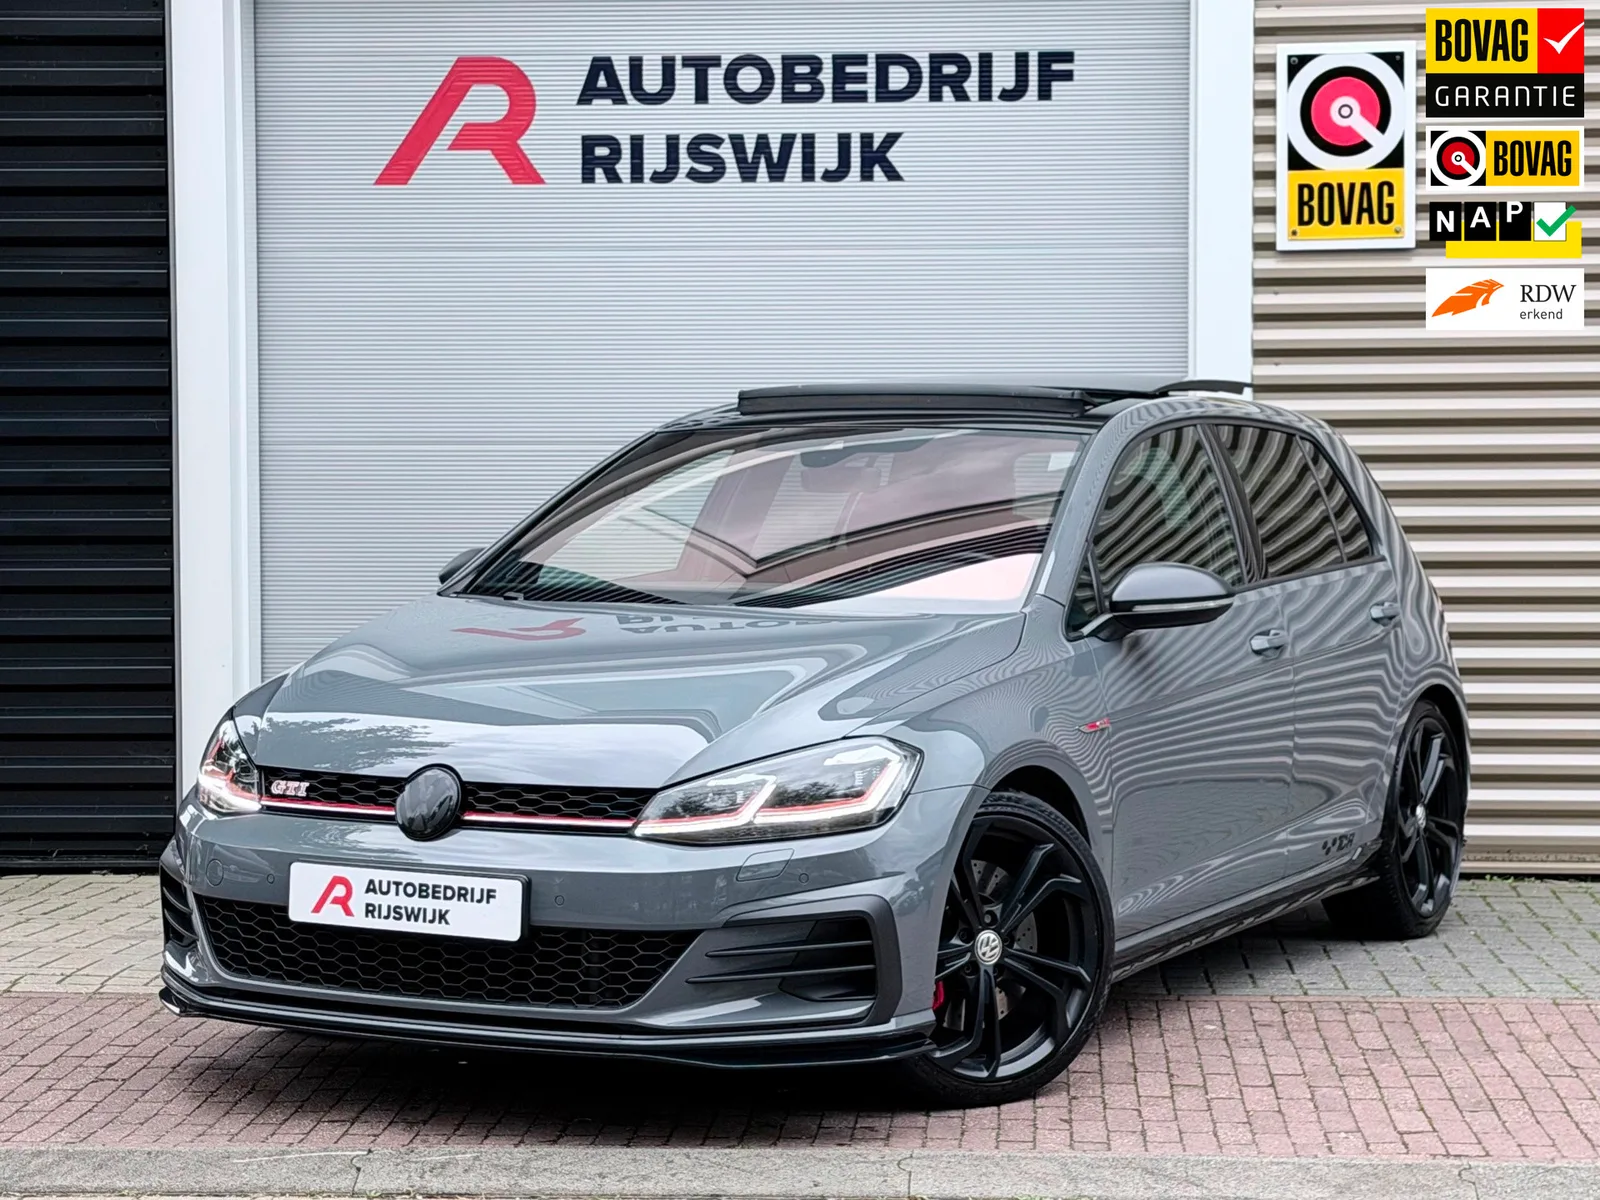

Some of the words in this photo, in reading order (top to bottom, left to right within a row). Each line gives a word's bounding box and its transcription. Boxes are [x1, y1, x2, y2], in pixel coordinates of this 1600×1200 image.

[576, 52, 1075, 105] AUTOBEDRIJF
[581, 133, 905, 183] RIJSWIJK
[1297, 181, 1395, 227] BOVAG
[271, 780, 310, 797] GTI
[365, 878, 497, 904] AUTOBEDRIJF
[364, 902, 450, 926] RIJSWIJK
